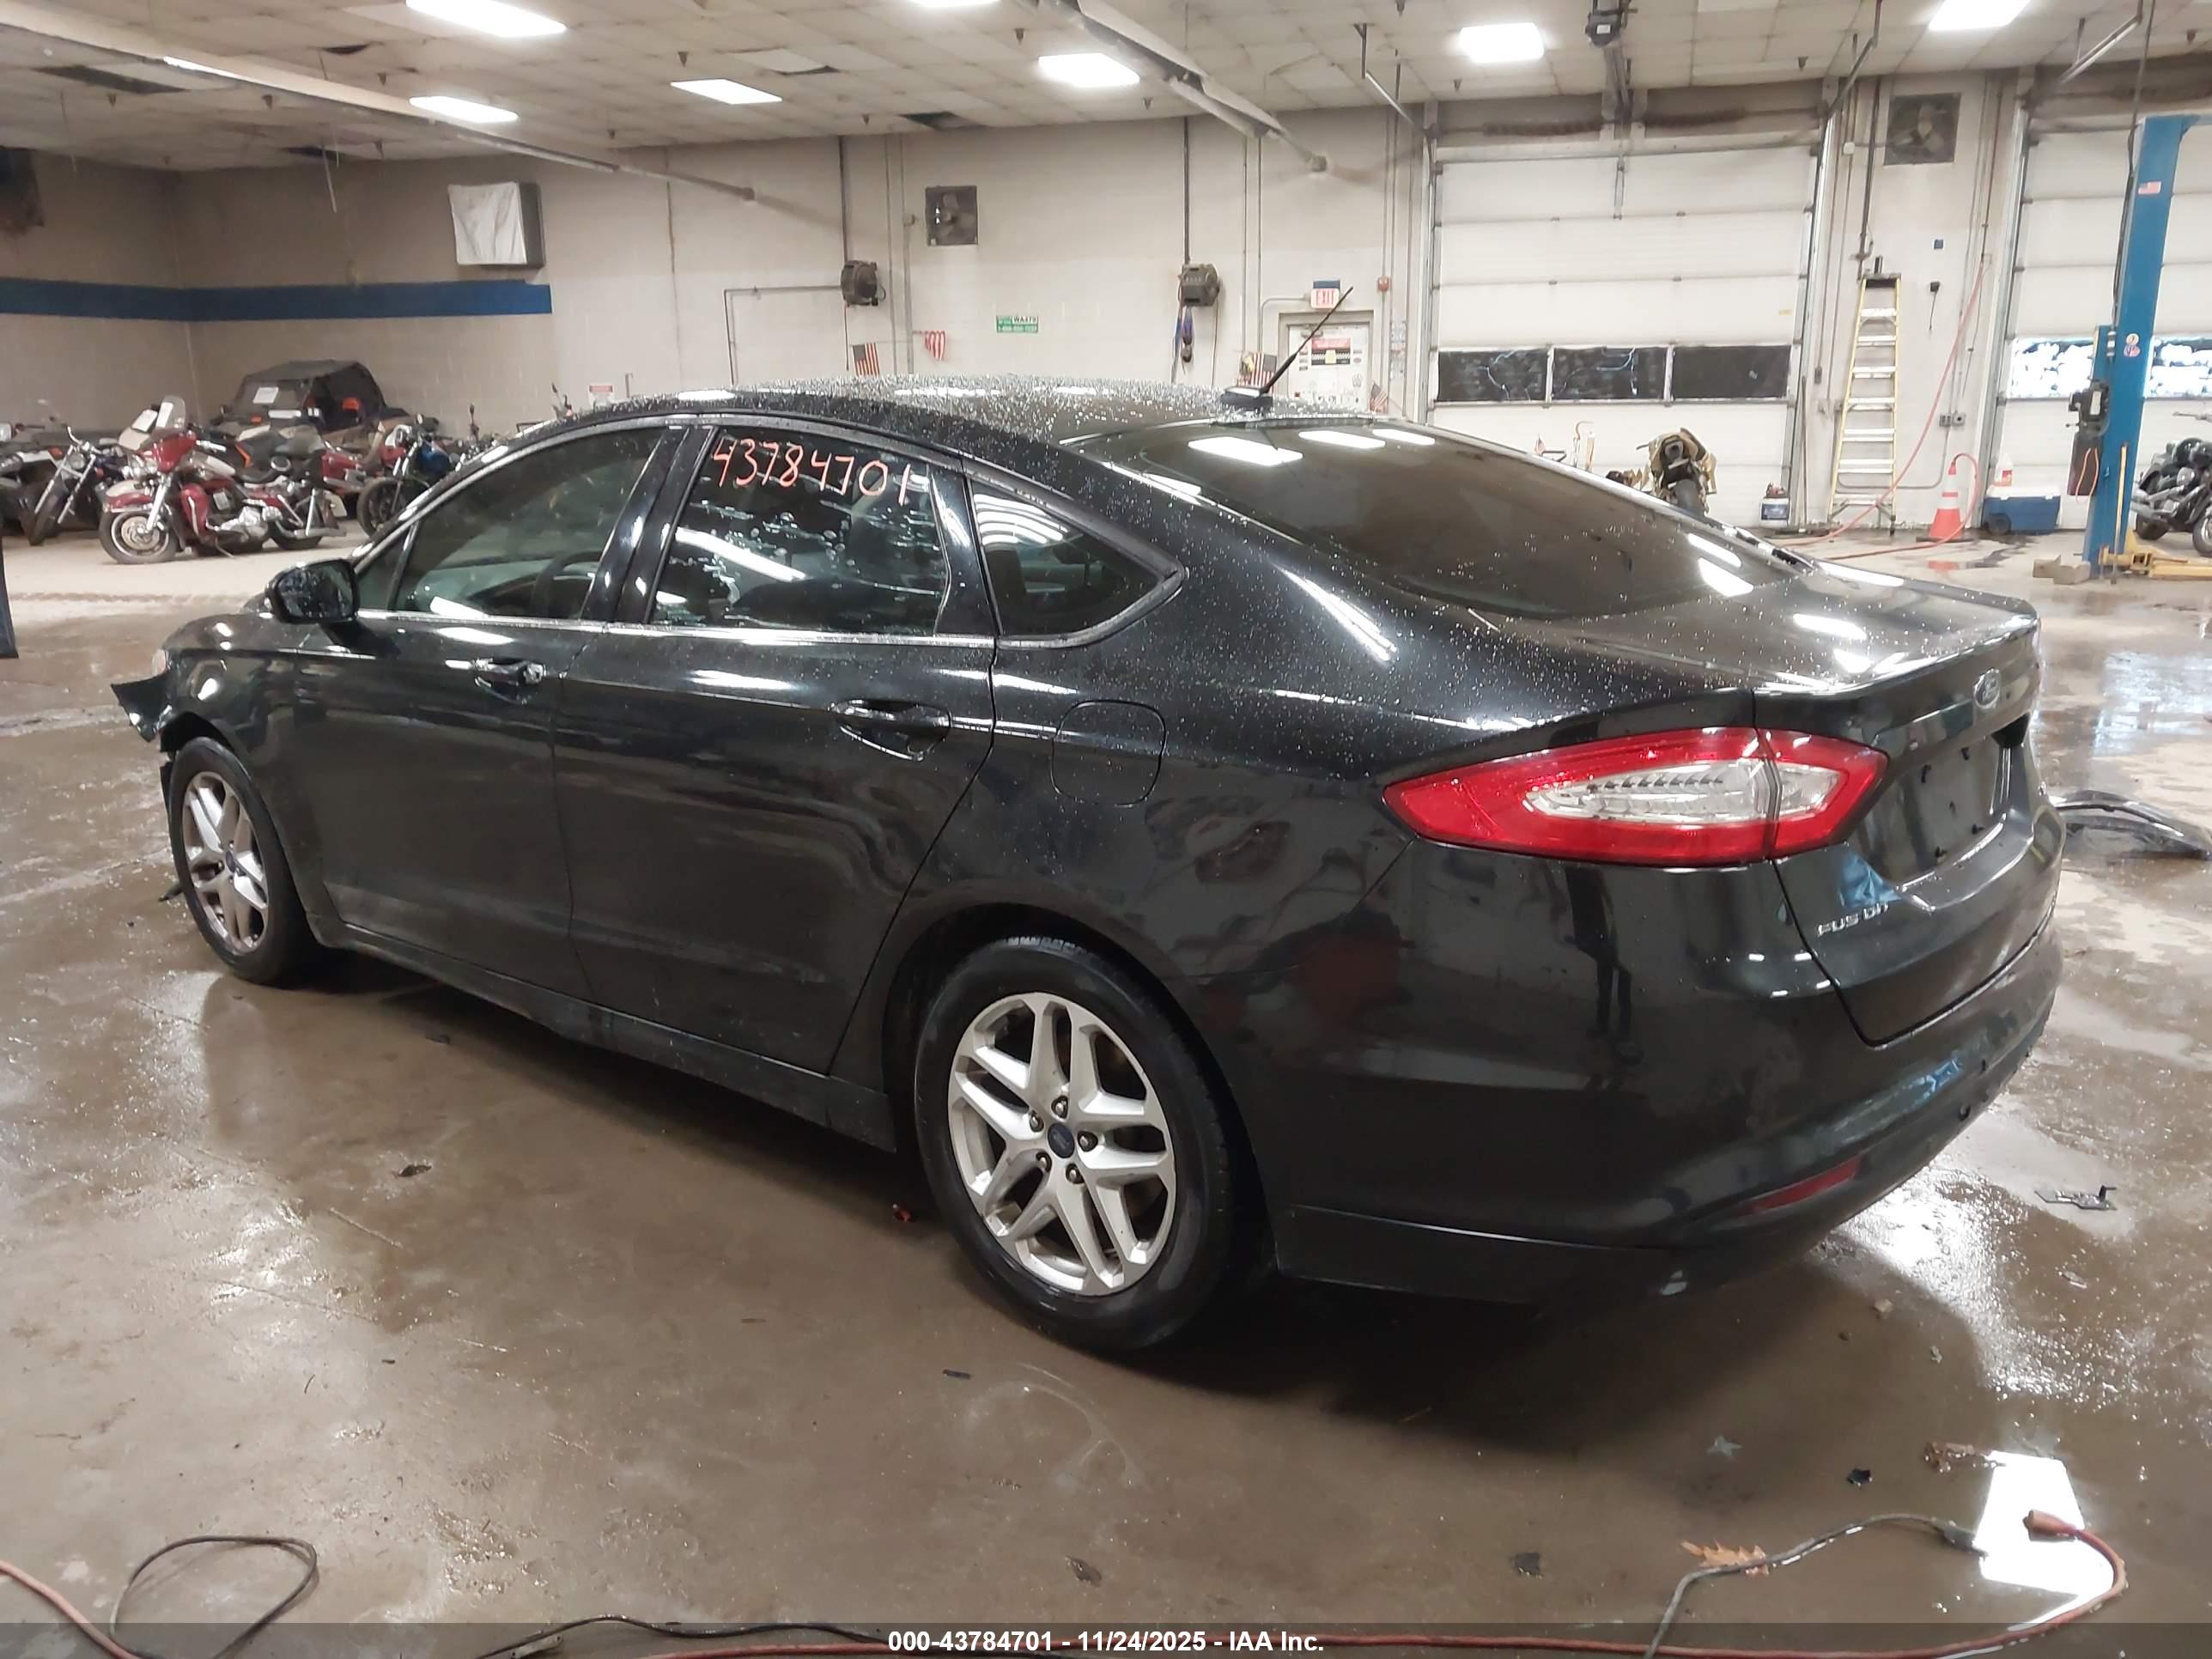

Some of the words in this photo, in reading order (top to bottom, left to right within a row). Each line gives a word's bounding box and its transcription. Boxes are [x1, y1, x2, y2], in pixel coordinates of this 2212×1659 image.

[1316, 289, 1335, 306] EXIT
[713, 437, 911, 506] 43784701
[1817, 902, 1889, 938] FUSON
